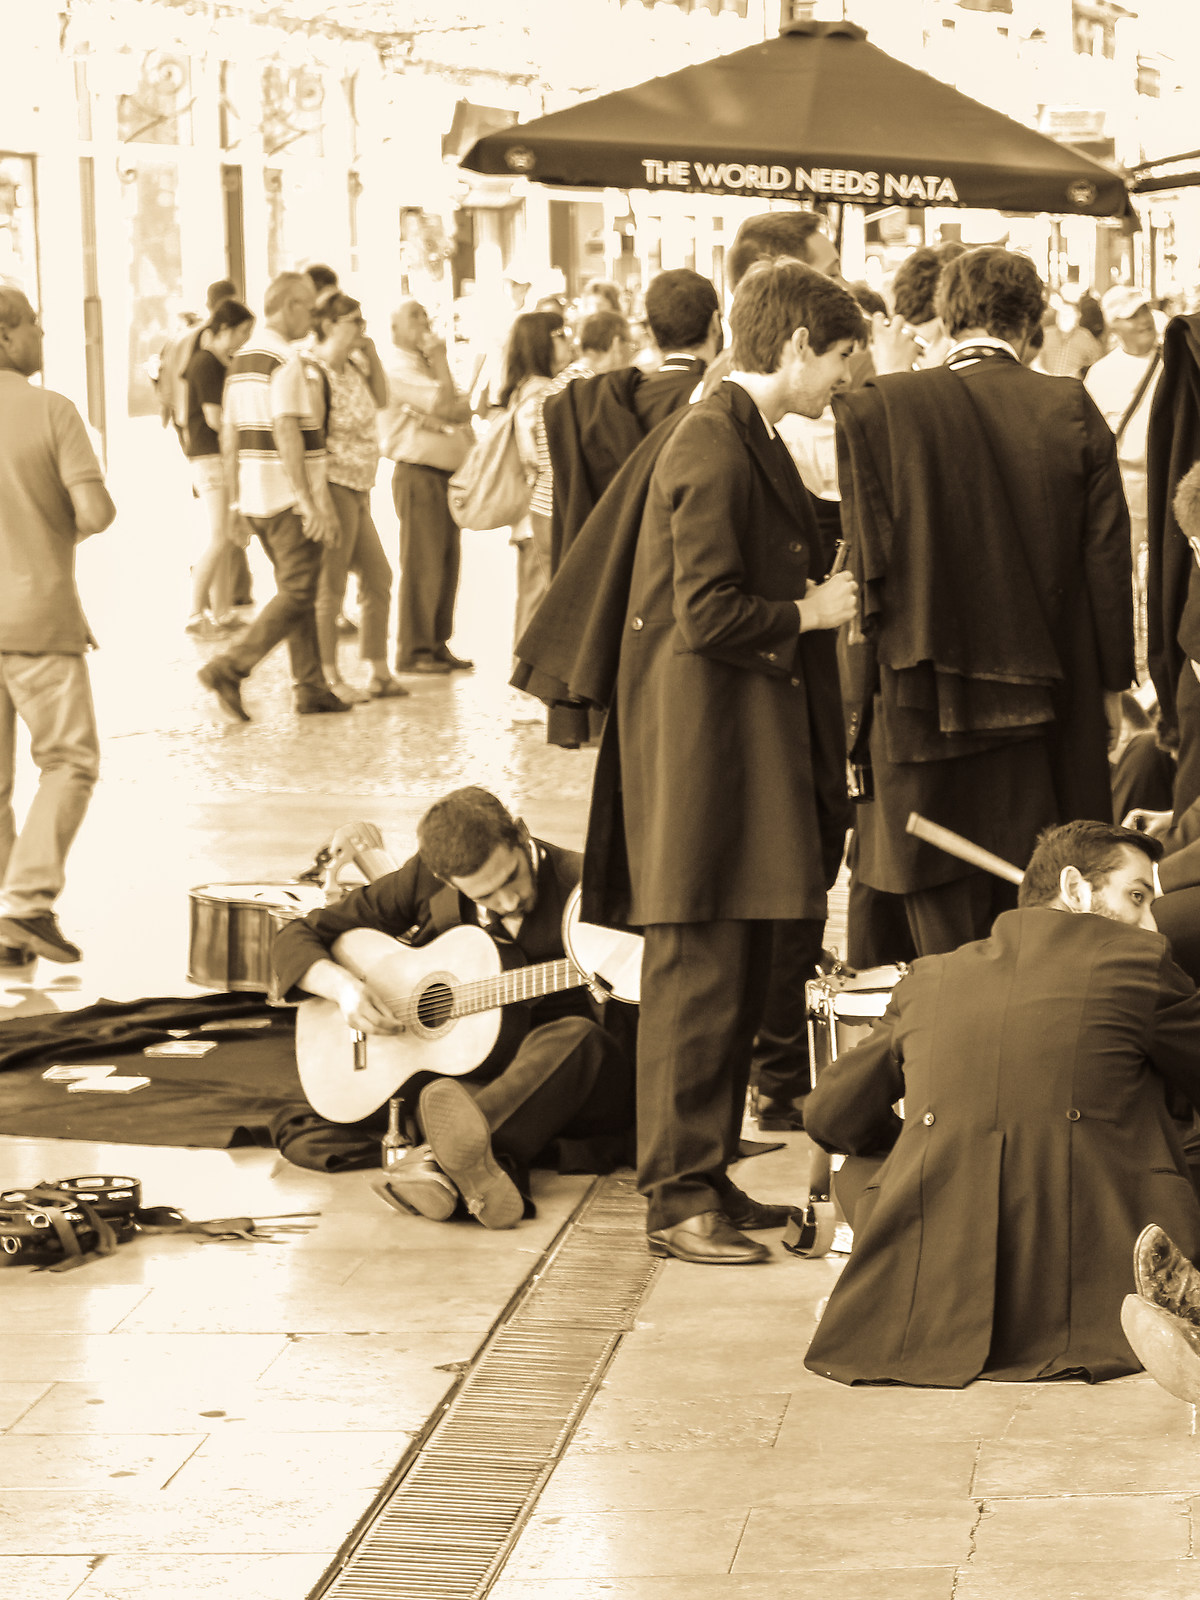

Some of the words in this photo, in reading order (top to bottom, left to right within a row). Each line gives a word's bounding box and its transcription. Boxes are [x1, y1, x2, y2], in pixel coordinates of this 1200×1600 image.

[641, 159, 690, 186] THE
[693, 161, 792, 191] WORLD
[795, 166, 880, 197] NEEDS
[884, 172, 959, 202] NATA
